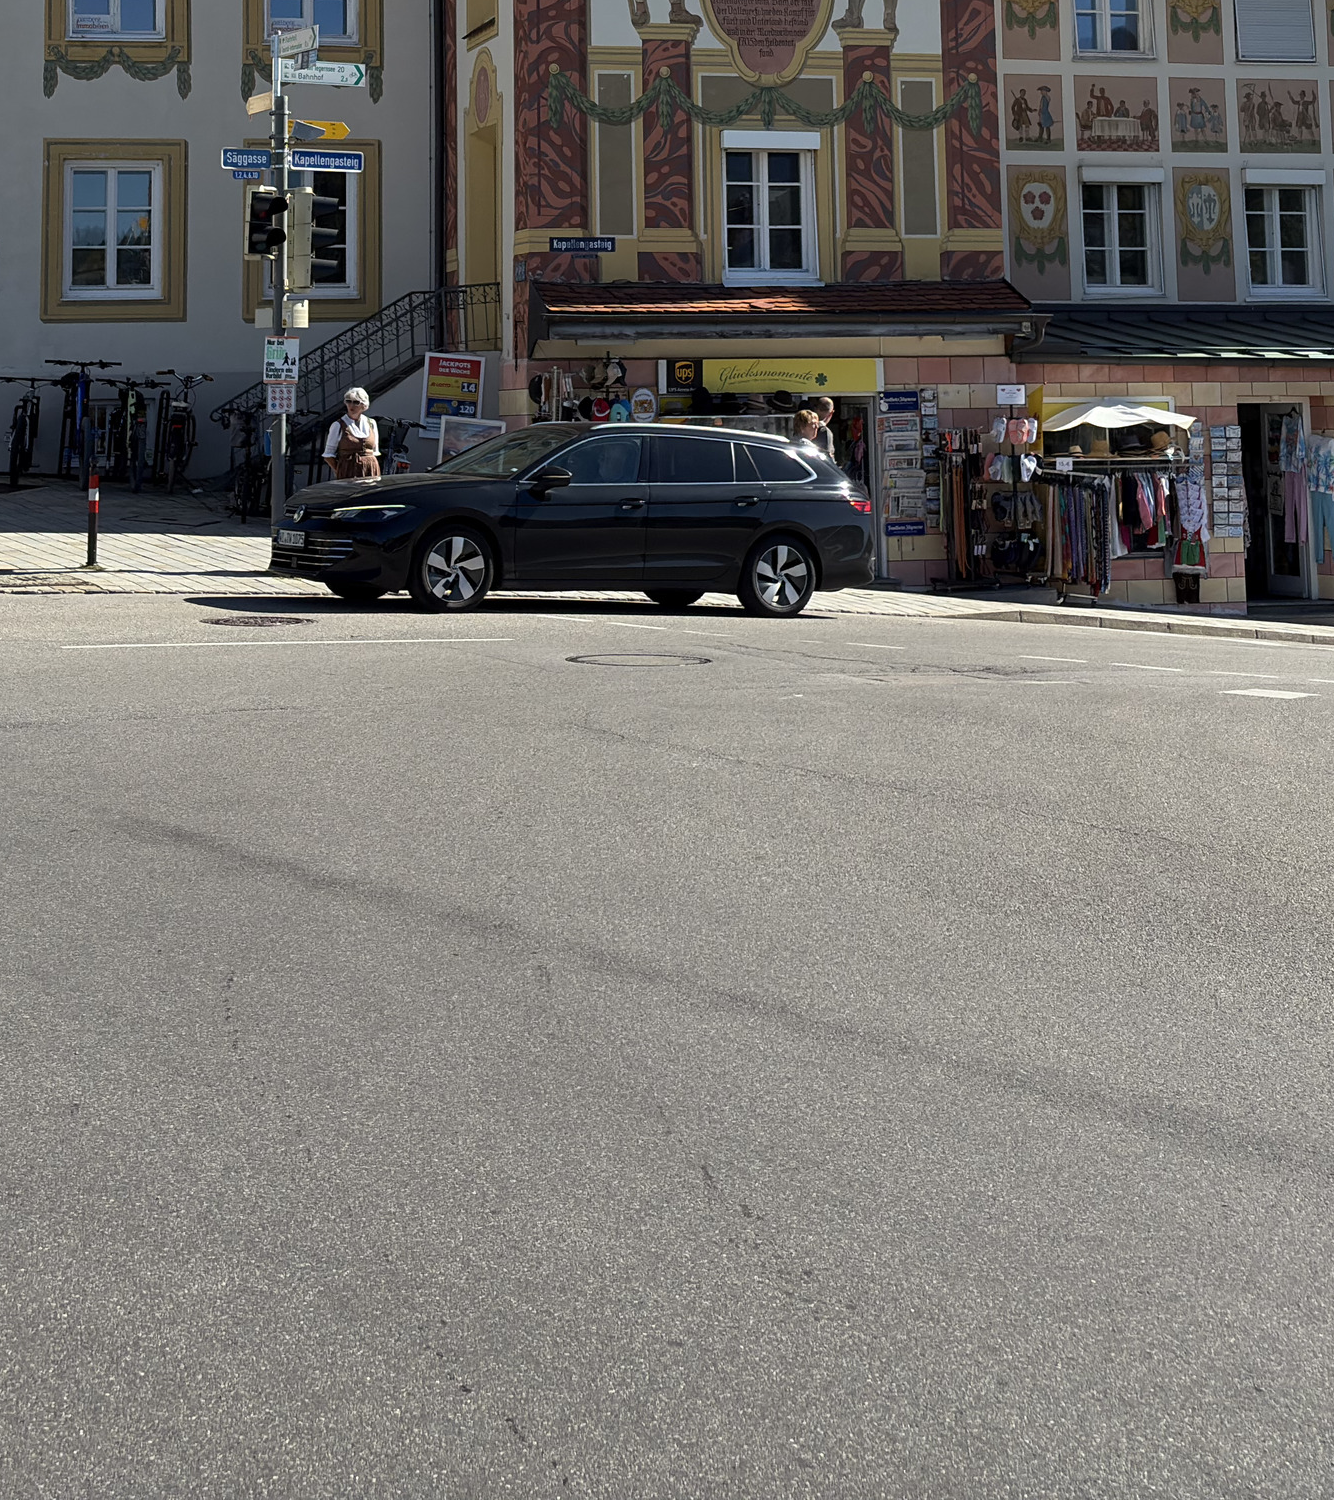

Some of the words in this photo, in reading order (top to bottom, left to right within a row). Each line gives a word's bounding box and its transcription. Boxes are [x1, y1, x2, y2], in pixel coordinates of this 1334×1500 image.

[298, 72, 324, 81] Bahnhof
[226, 151, 267, 166] Säggasse
[294, 153, 360, 169] Kapellengasteig
[553, 239, 612, 251] Kapellengasteig
[677, 368, 692, 380] ups
[719, 360, 814, 390] Glücksmomente
[463, 383, 476, 392] 14
